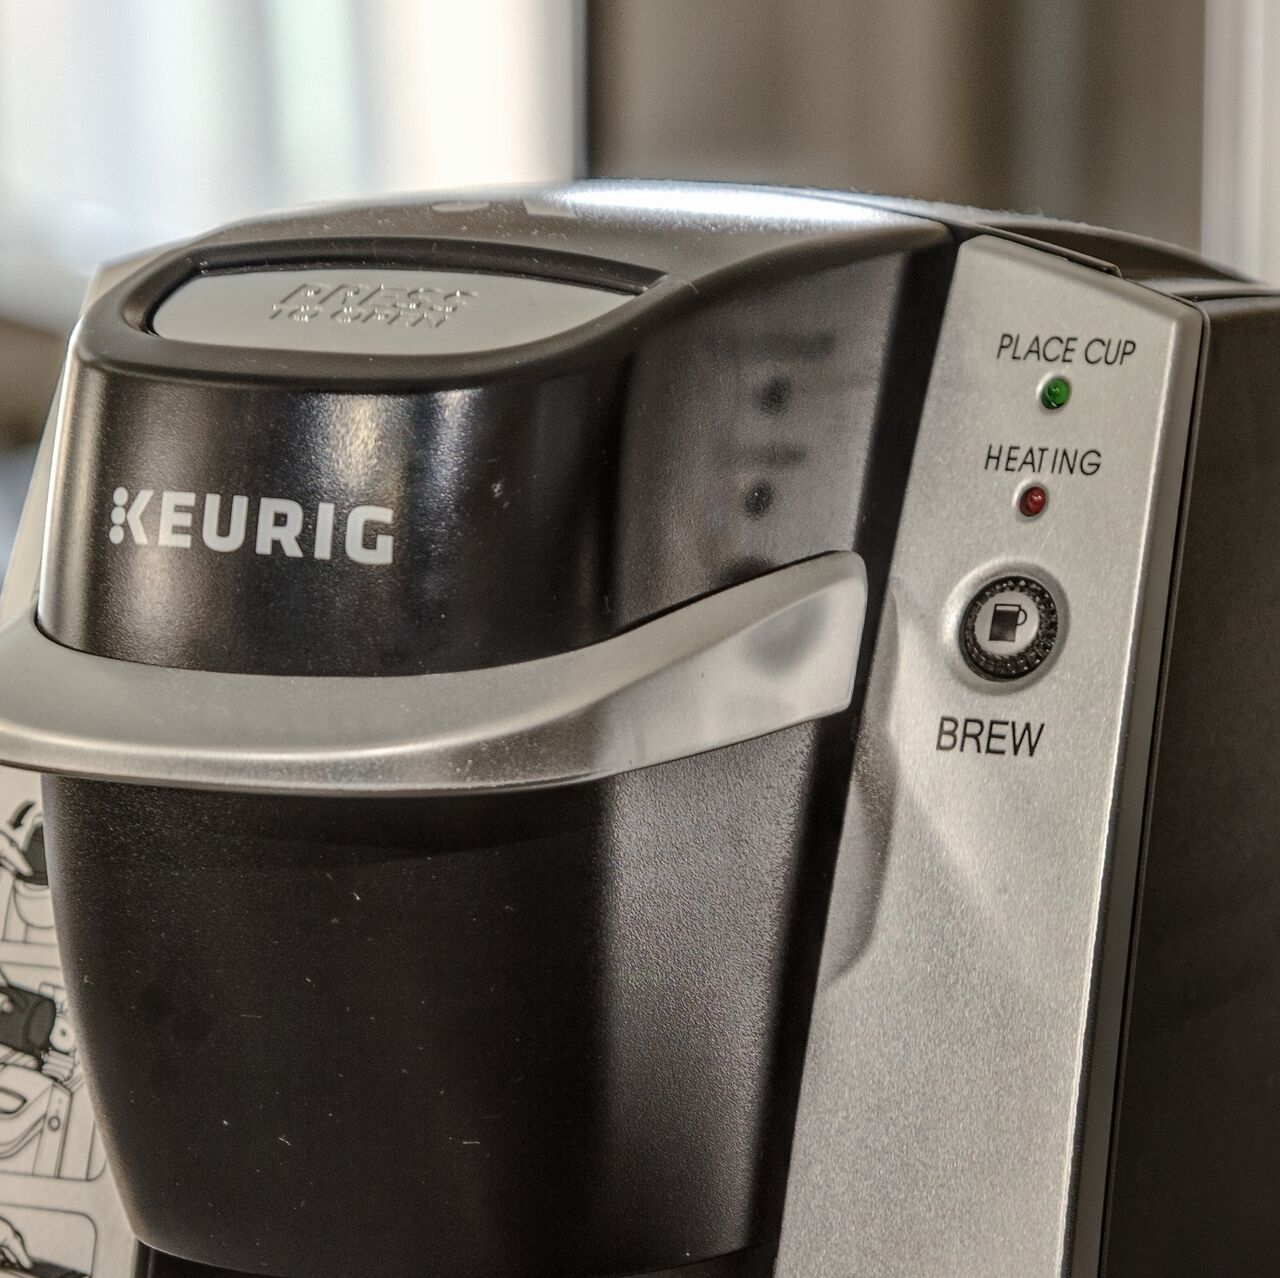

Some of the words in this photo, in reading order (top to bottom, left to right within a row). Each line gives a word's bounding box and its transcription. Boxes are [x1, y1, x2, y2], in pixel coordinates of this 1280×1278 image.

[279, 283, 478, 312] PRESS
[996, 333, 1078, 363] PLACE
[1084, 338, 1137, 366] CUP
[984, 444, 1102, 476] HEATING
[109, 486, 394, 565] KEURIG
[936, 716, 1045, 758] BREW
